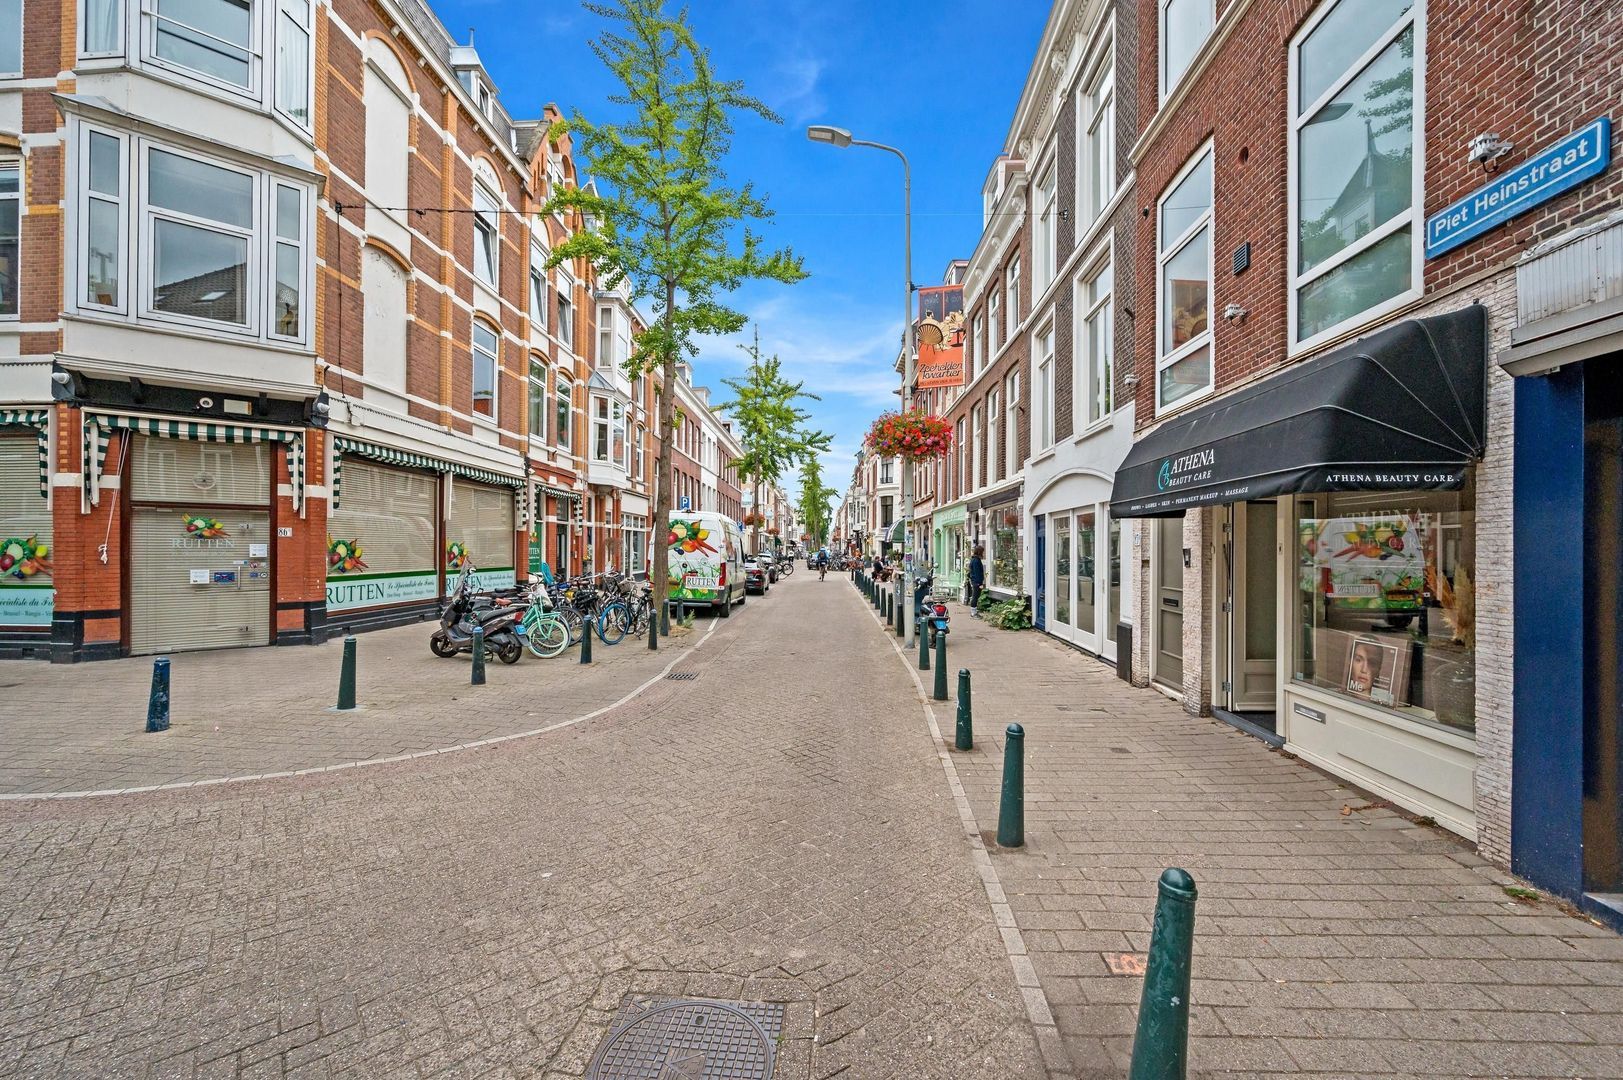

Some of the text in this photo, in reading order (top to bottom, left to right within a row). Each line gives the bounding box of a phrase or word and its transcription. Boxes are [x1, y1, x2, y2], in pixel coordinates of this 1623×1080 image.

[1434, 138, 1589, 238] Piet Heinstraat
[919, 362, 963, 373] Zeehelden
[922, 369, 961, 380] kwartier
[1171, 449, 1215, 474] ATHENA
[1168, 470, 1212, 487] BEAUTY CARE
[1326, 474, 1454, 482] ATHENA BEAUTY CARE
[1199, 492, 1218, 501] MAKEUP
[1225, 486, 1249, 497] MASSAGE
[172, 538, 235, 548] RUTTEN
[686, 577, 716, 587] RUTTEN
[325, 582, 385, 605] RUTTEN
[1350, 681, 1362, 692] Me
